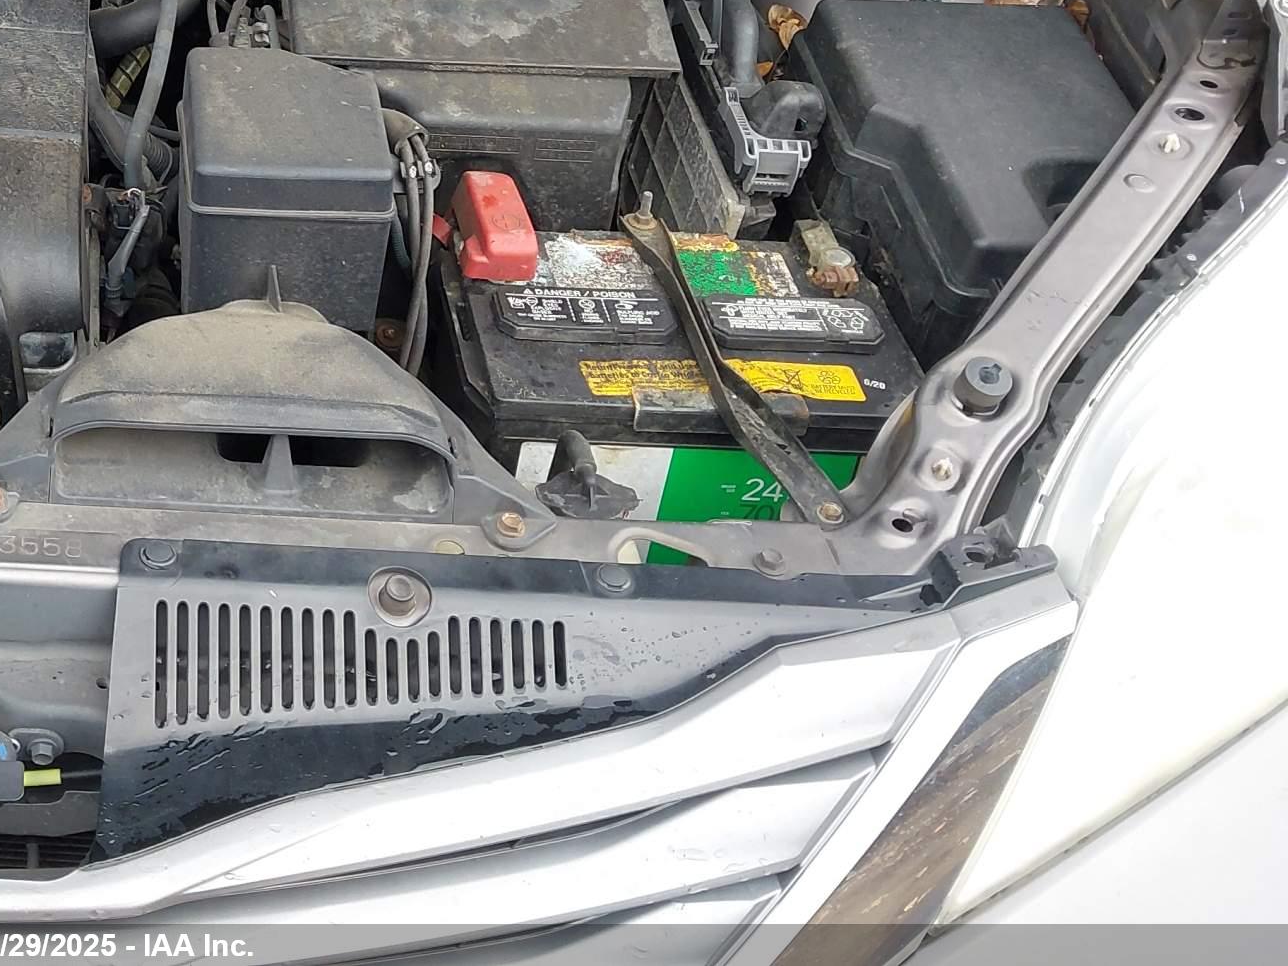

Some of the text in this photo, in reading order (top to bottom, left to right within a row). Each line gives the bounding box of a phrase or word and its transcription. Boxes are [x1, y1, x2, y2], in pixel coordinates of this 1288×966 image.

[534, 288, 582, 297] DANGER
[593, 290, 636, 299] POISON
[741, 478, 783, 502] 24
